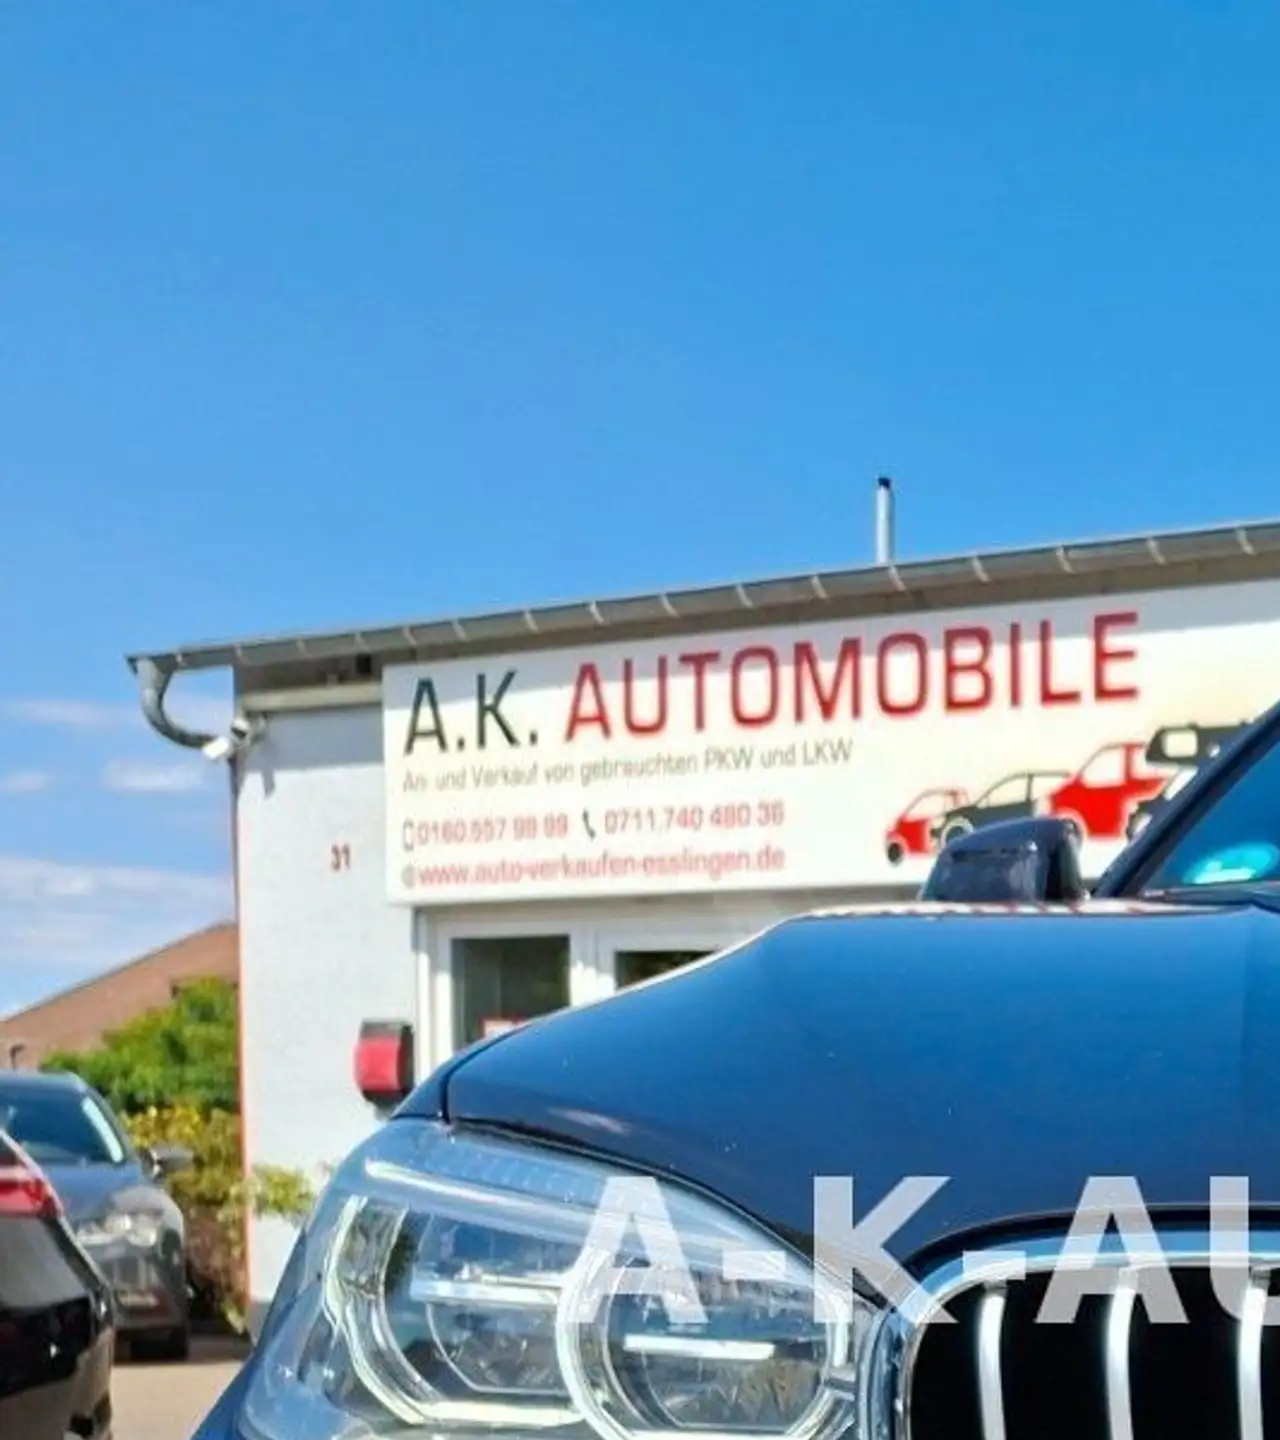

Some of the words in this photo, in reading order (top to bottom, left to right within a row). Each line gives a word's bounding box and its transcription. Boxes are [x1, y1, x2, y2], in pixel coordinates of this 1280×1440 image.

[403, 668, 538, 757] A.K.
[563, 610, 1141, 744] AUTOMOBILE
[435, 767, 467, 790] und
[472, 760, 538, 788] Verkauf
[545, 764, 574, 783] von
[581, 752, 698, 787] gebrauchten
[703, 744, 754, 771] PKW
[760, 742, 796, 768] und
[802, 736, 853, 765] LKW
